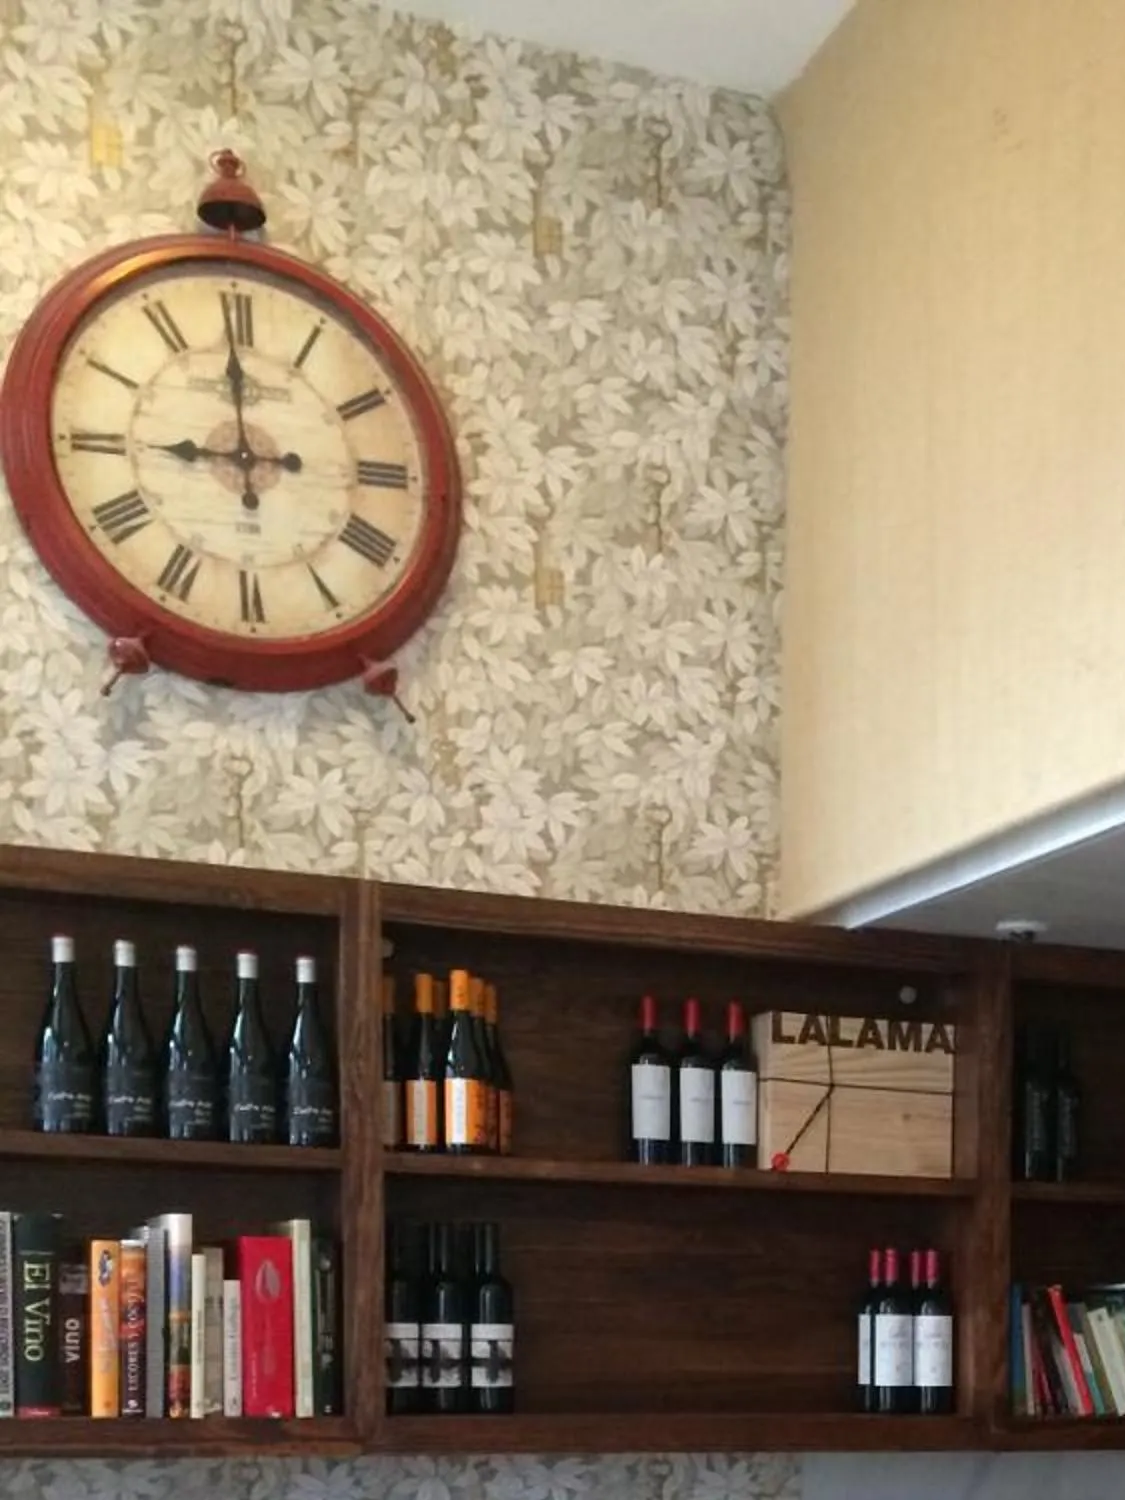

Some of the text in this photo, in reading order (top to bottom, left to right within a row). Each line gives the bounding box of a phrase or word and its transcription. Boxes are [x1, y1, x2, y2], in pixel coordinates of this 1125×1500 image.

[772, 1010, 957, 1055] LALAMA
[23, 1260, 51, 1361] El Vino
[64, 1318, 81, 1362] vino
